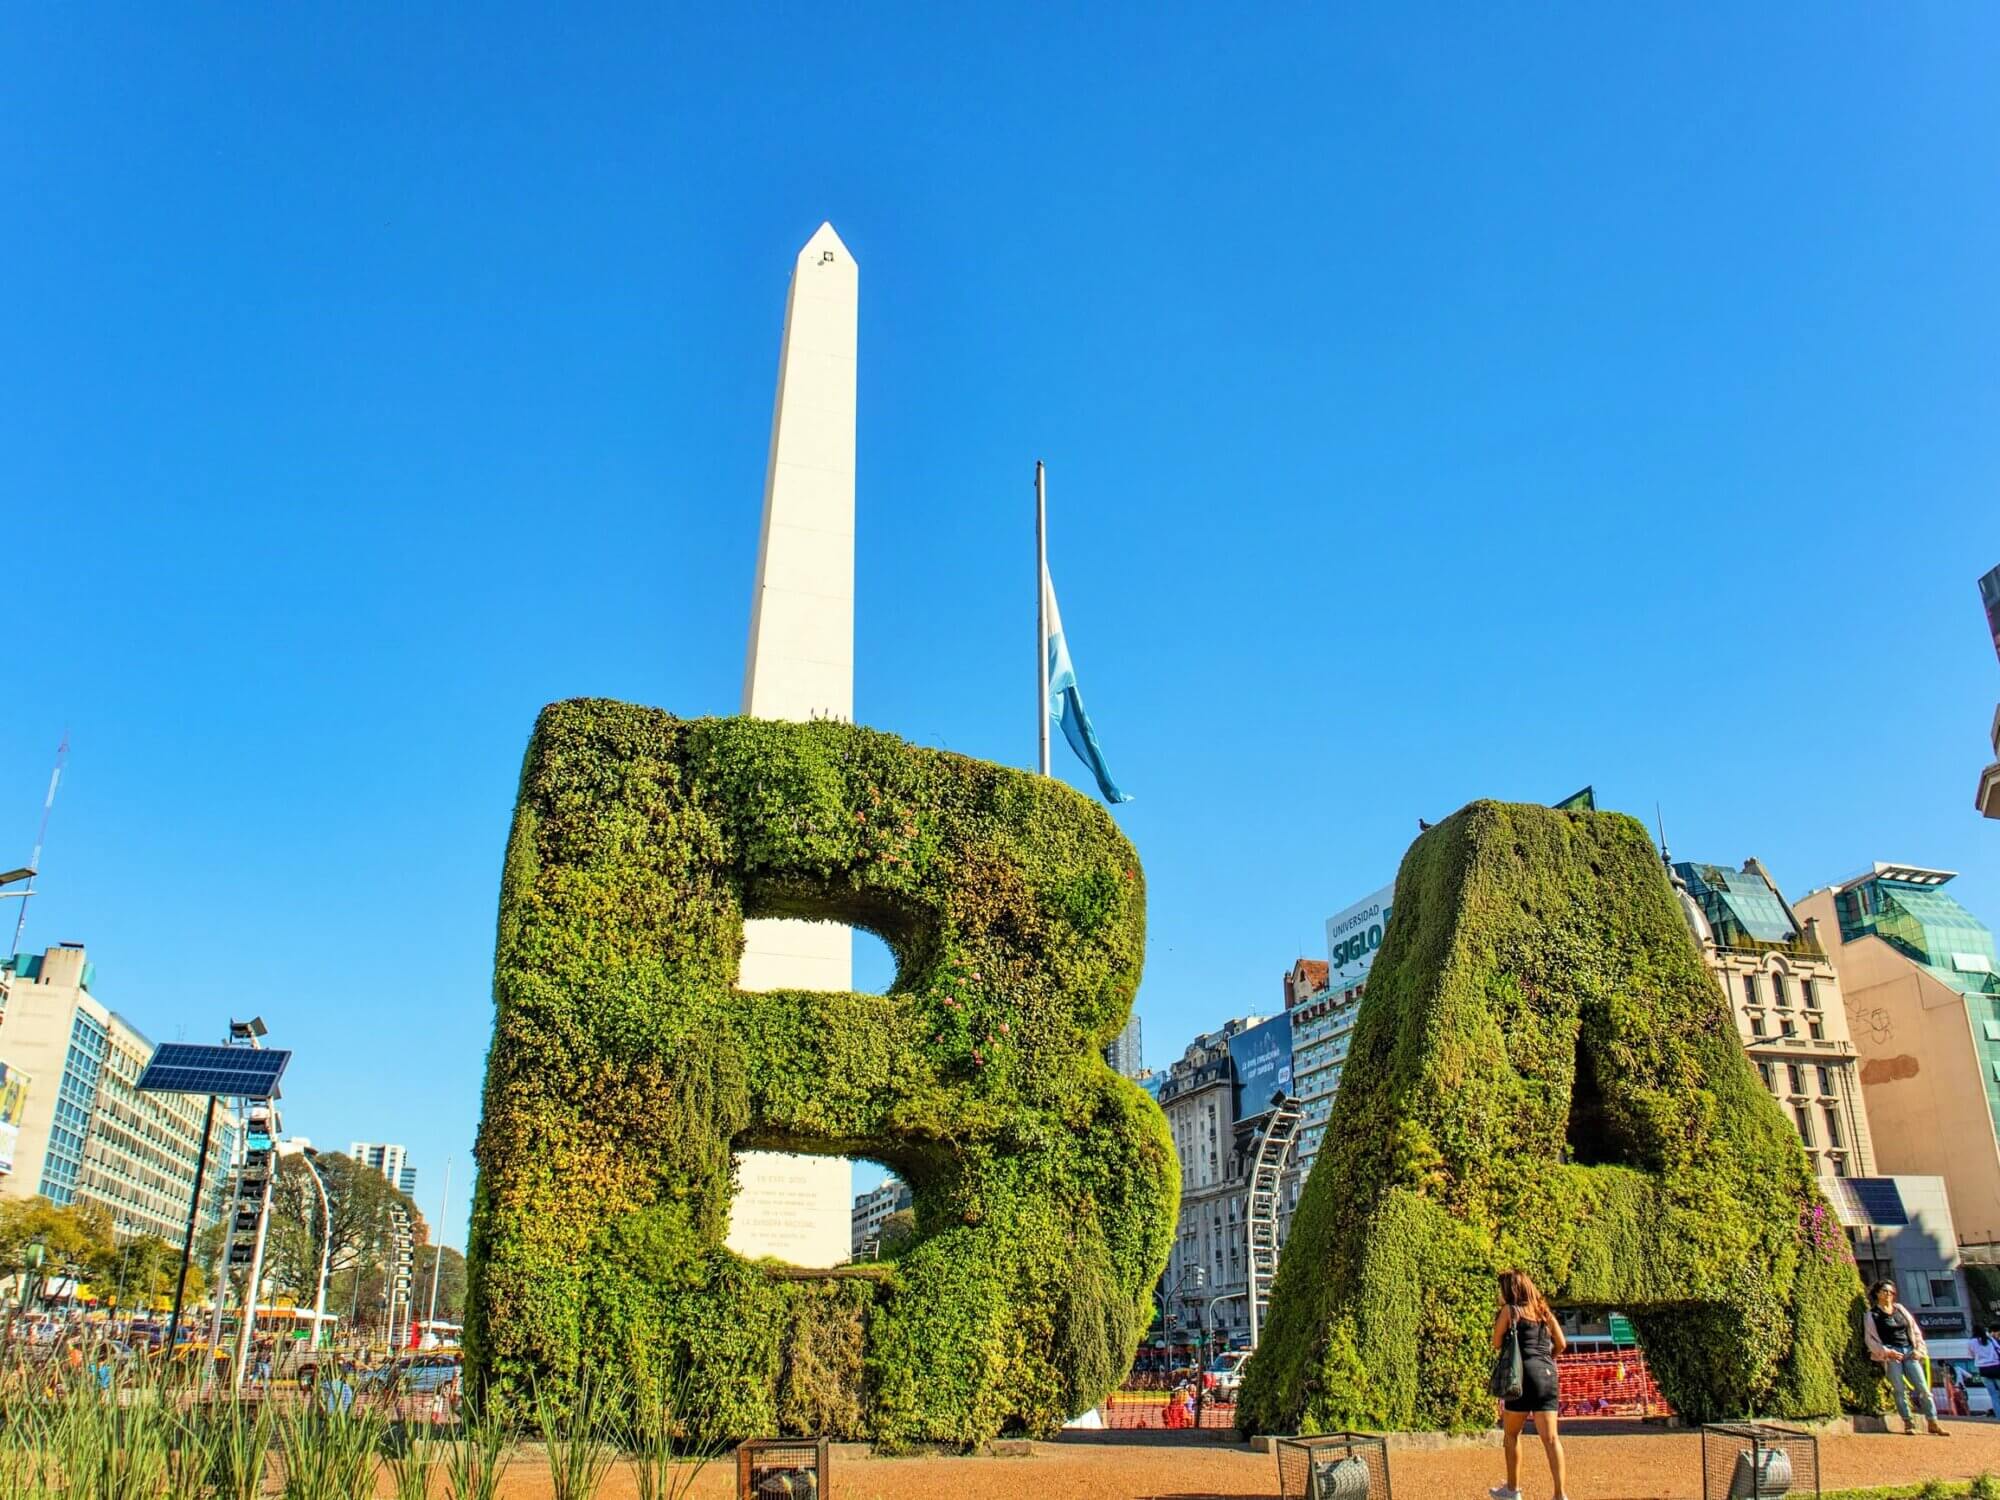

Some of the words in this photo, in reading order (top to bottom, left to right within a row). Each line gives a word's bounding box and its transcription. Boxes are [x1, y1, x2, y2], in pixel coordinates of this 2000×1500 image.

[1332, 904, 1380, 938] UNIVERSIDAD
[1333, 924, 1382, 969] SIGLO
[1929, 1316, 1962, 1326] Santander
